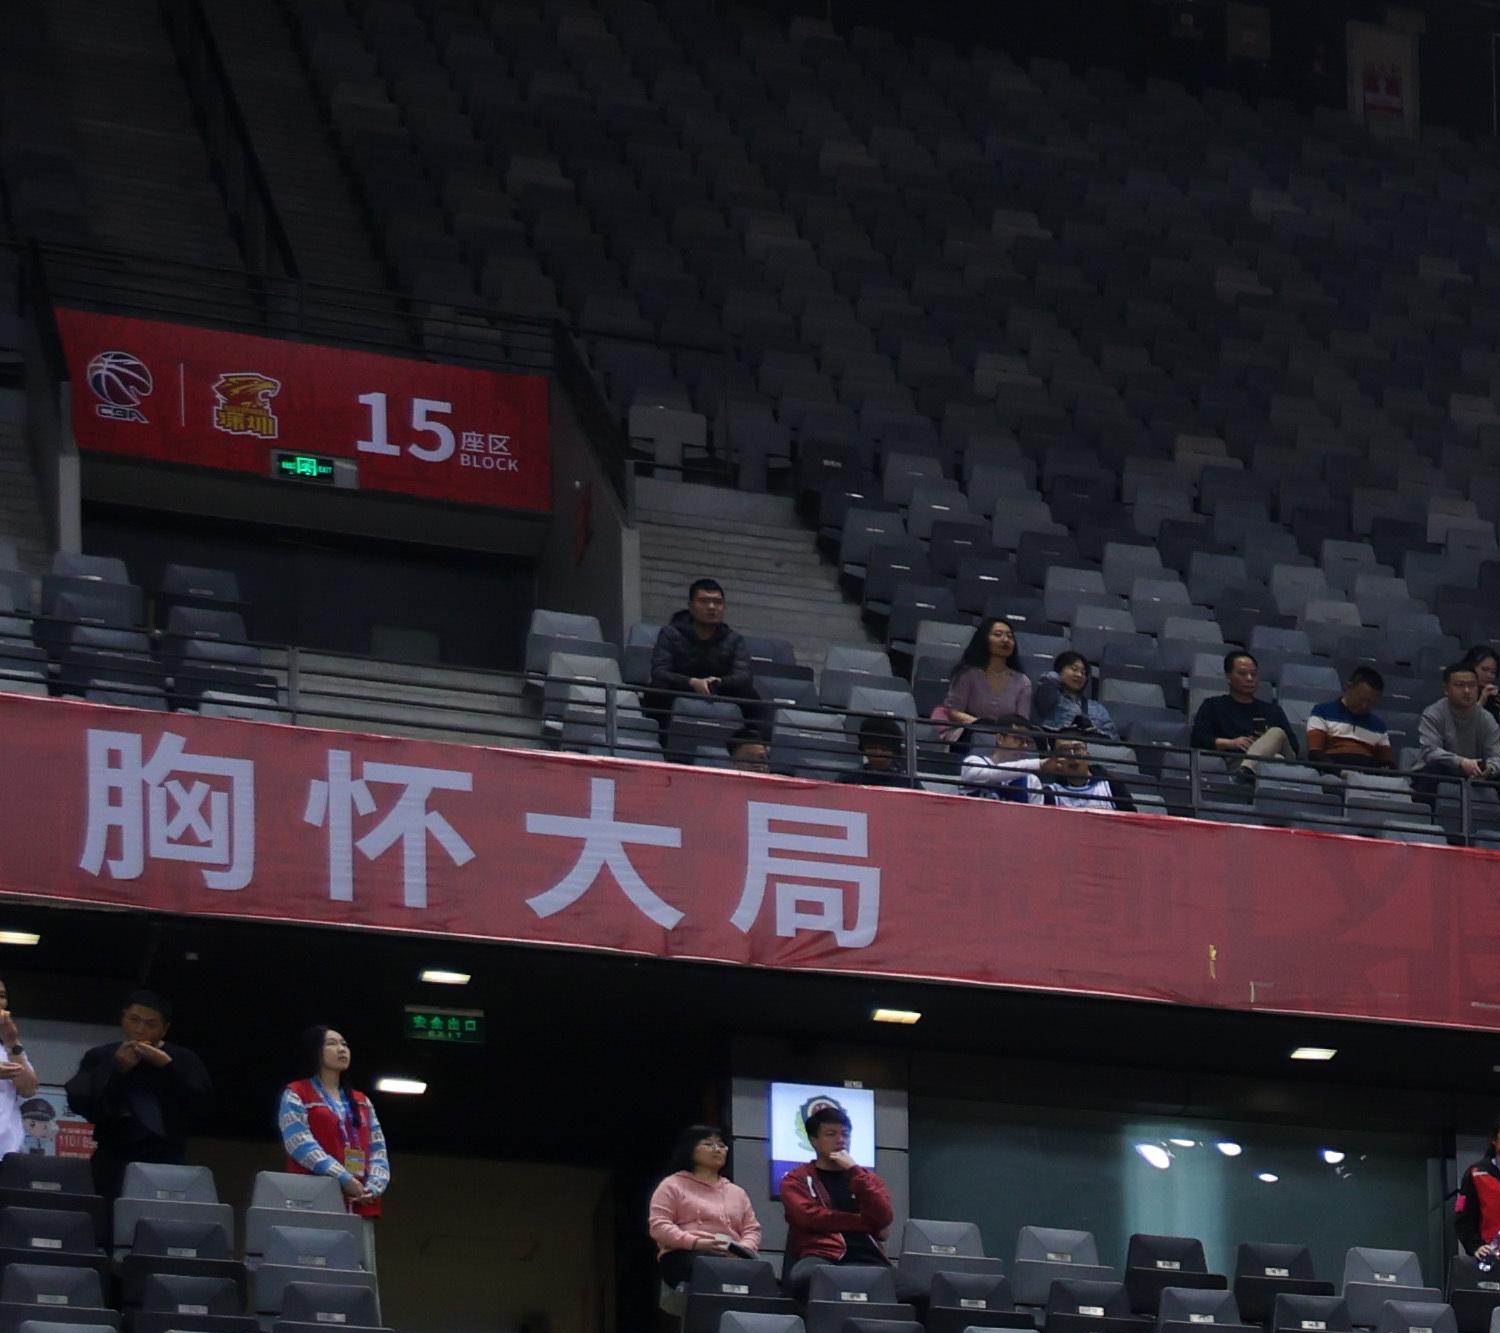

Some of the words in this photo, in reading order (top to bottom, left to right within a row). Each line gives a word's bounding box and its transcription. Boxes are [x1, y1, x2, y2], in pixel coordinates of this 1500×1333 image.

[357, 392, 456, 463] 15
[461, 432, 512, 456] 座区
[460, 455, 519, 473] BLOCK
[80, 728, 881, 948] 胸怀大局
